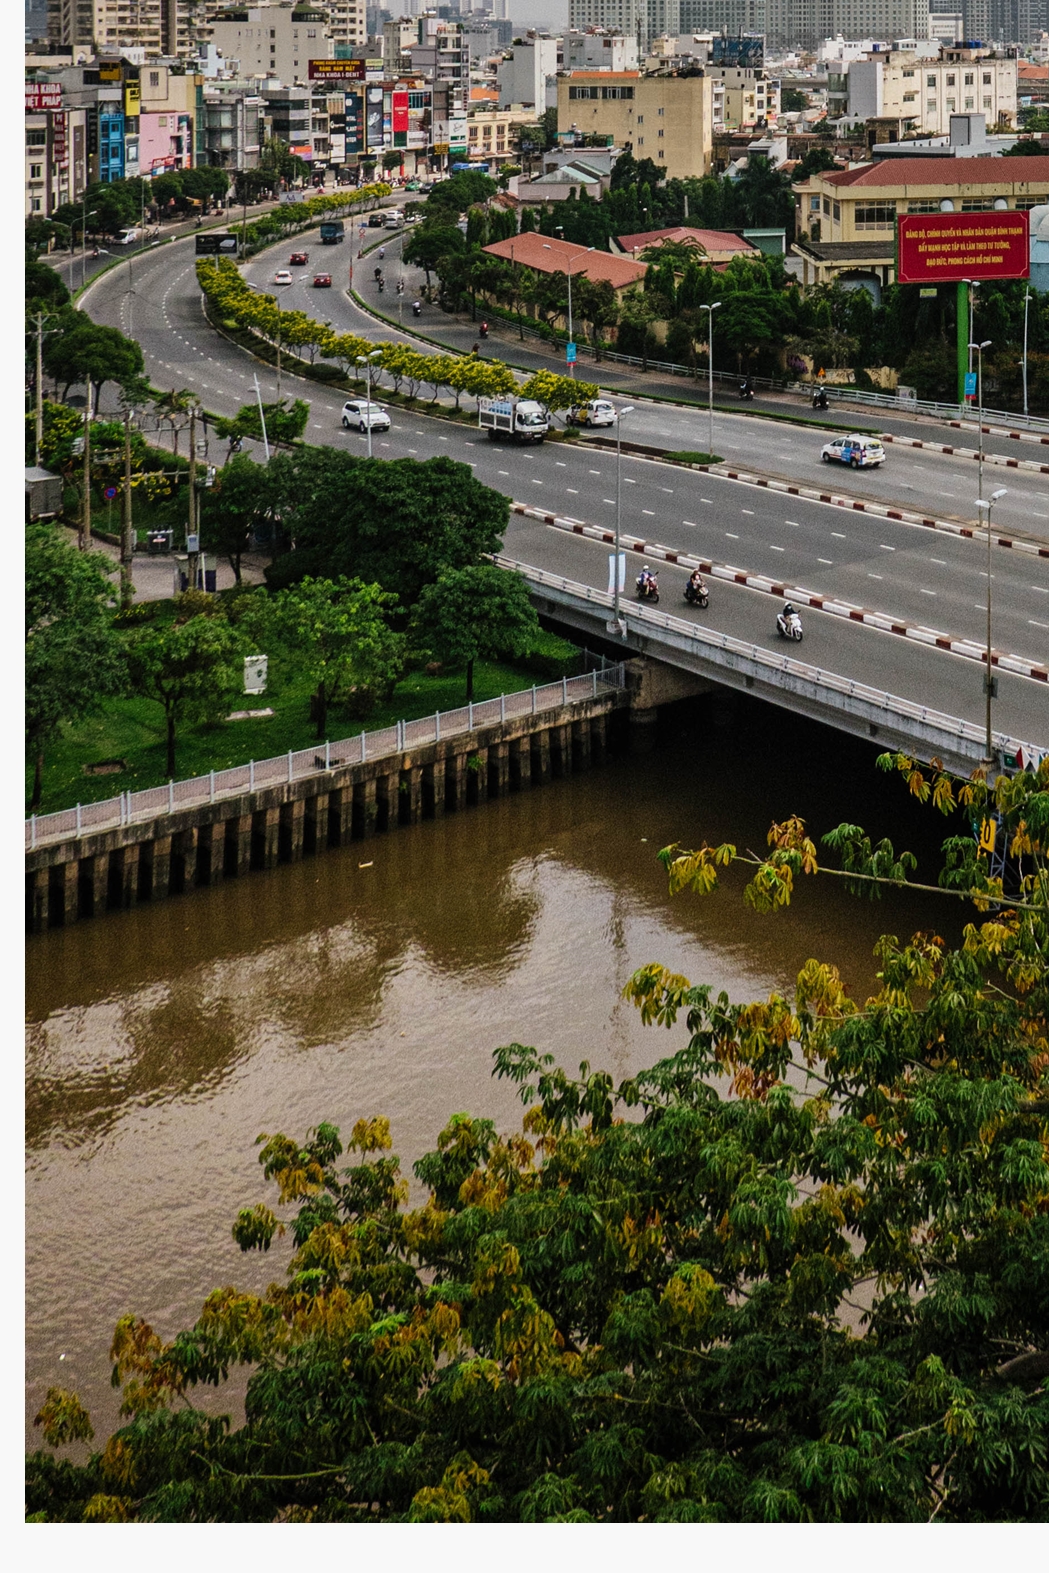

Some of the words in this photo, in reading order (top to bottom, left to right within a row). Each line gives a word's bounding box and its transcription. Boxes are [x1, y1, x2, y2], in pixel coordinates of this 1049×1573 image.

[40, 83, 61, 94] KHOA
[42, 94, 61, 106] PHÁP
[927, 228, 940, 238] CHÍNH
[985, 226, 997, 237] QUẬN
[998, 226, 1008, 235] BÌNH
[942, 243, 951, 252] HỌC
[951, 242, 960, 252] TẬP
[966, 241, 976, 250] LÀM
[976, 242, 987, 250] THEO
[947, 257, 963, 265] PHONG
[963, 256, 976, 265] CÁCH
[983, 254, 991, 263] CHÍ
[992, 255, 1003, 263] MINH
